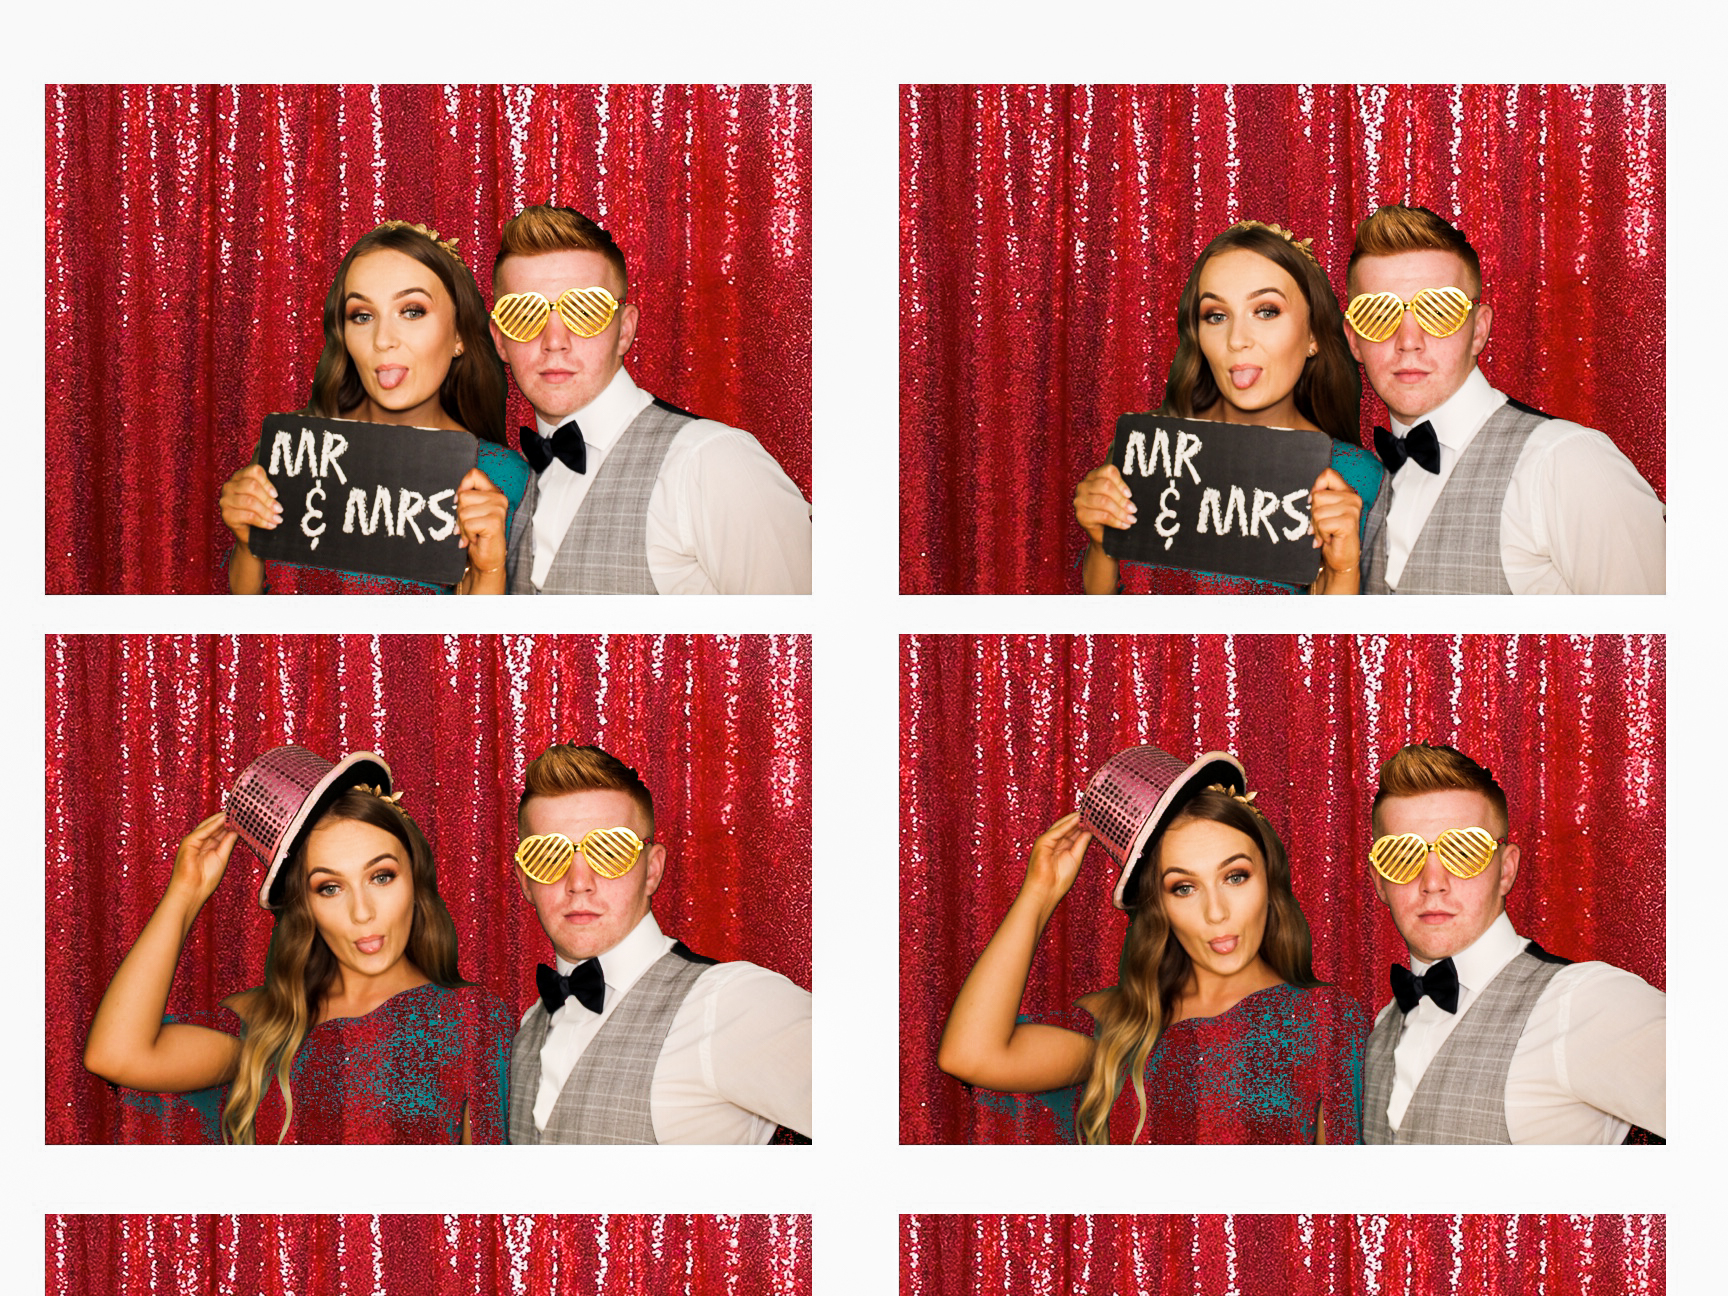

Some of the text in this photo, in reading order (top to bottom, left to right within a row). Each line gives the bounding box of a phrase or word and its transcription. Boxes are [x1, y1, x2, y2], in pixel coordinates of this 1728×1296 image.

[268, 427, 349, 485] MR
[1122, 427, 1203, 485] MR
[300, 479, 459, 551] & MRS
[1154, 479, 1313, 551] & MRS
